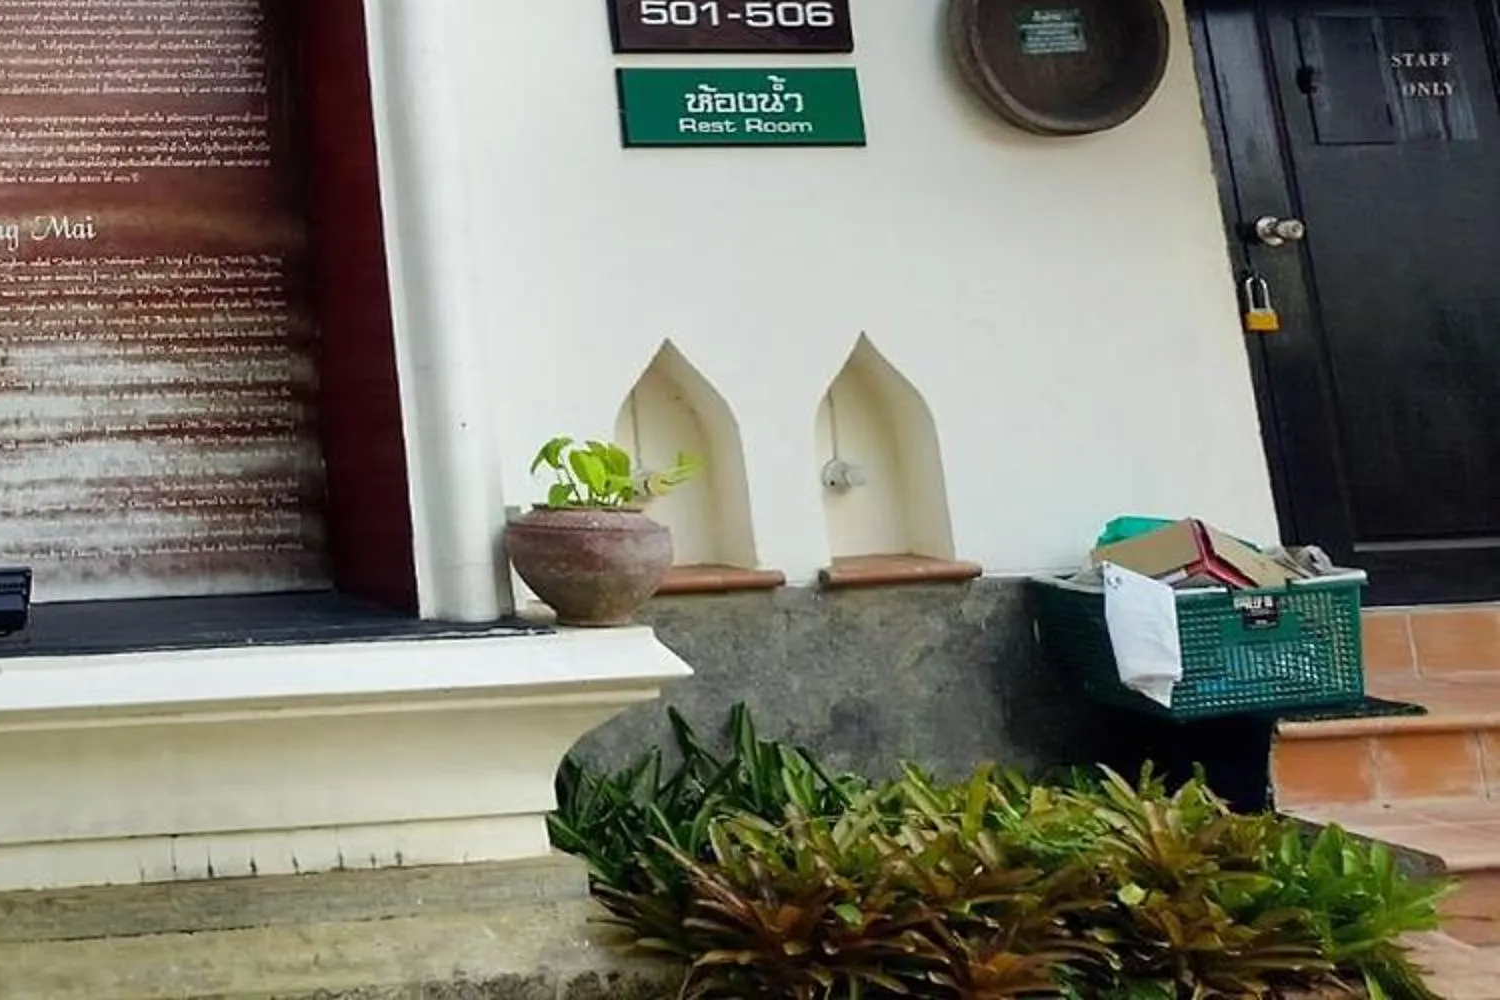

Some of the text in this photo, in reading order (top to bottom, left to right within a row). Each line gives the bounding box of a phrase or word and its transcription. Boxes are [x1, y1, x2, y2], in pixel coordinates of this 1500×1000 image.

[1391, 52, 1452, 67] STAFF
[685, 75, 804, 113] ห้องน้ำ
[1402, 82, 1453, 96] ONLY
[680, 118, 812, 133] Rest Room
[31, 216, 97, 241] Mai
